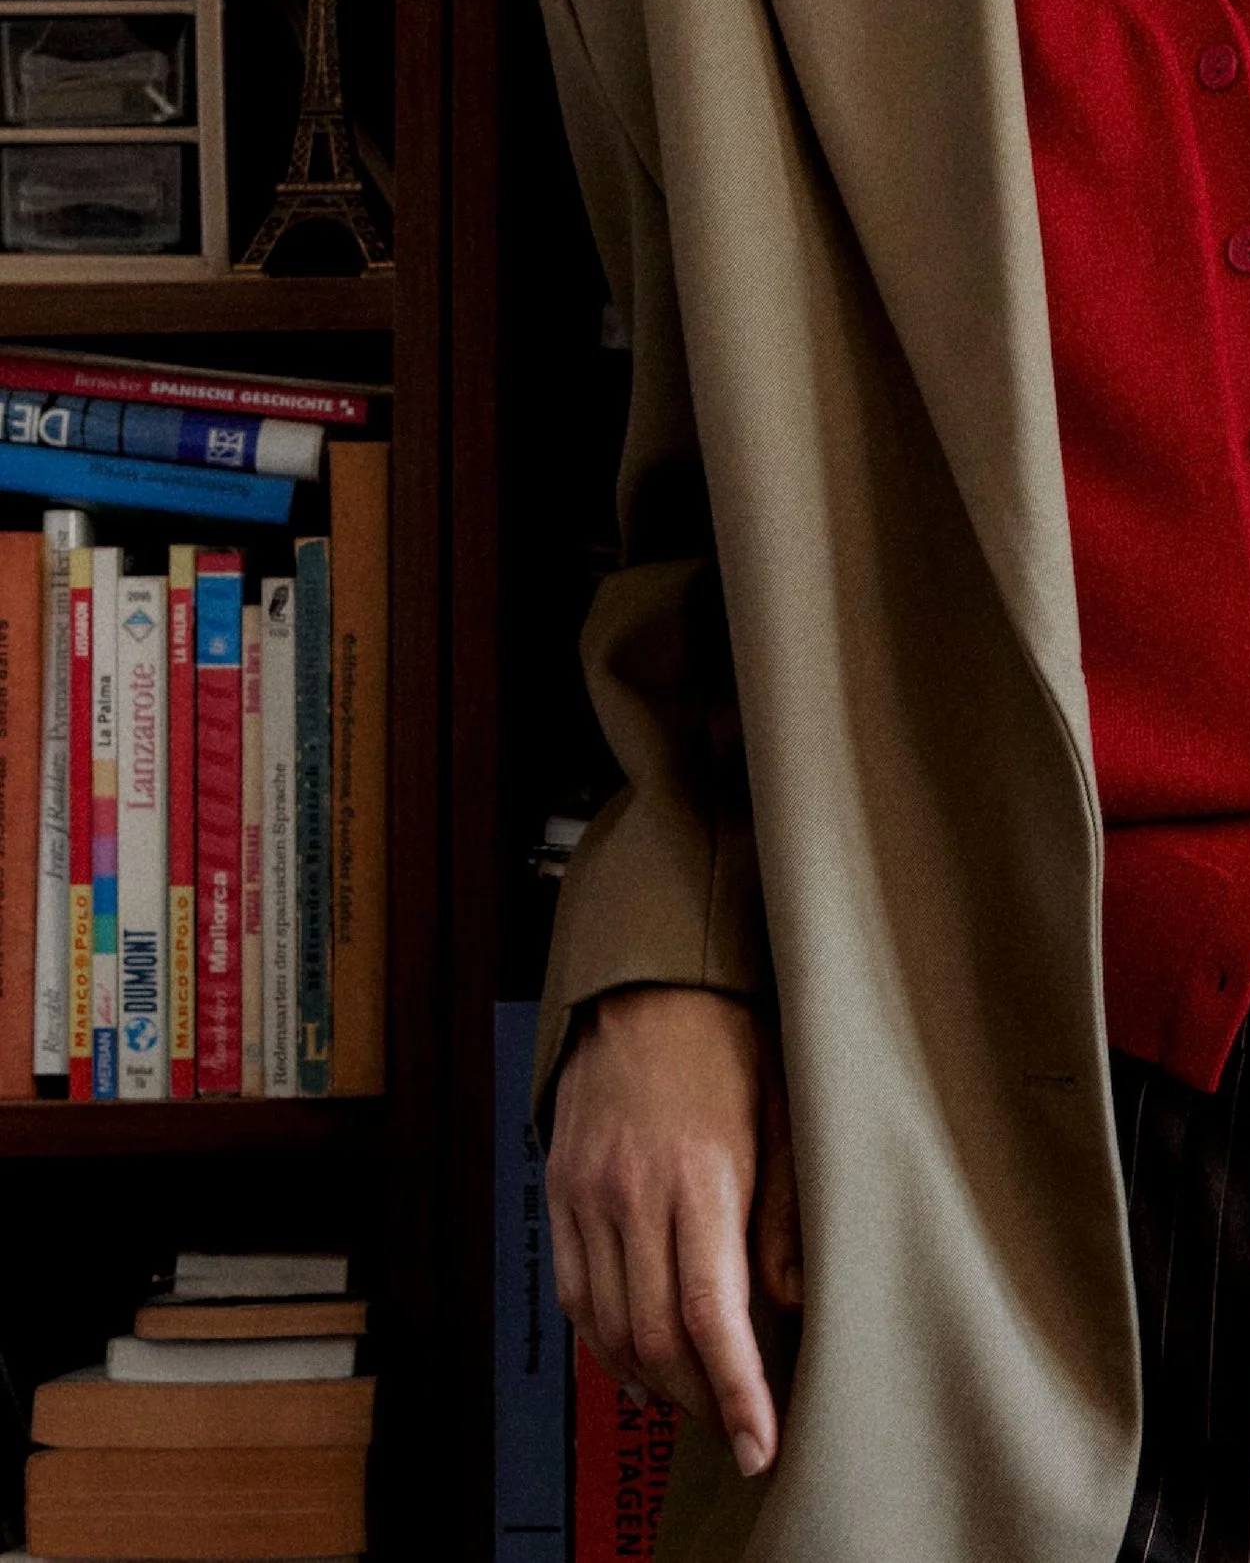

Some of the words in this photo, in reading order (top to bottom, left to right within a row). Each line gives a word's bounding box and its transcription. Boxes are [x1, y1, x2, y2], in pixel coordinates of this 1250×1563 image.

[149, 380, 236, 402] SPANISCHE
[239, 390, 335, 414] GESCHICHTE
[97, 674, 113, 725] Palma
[97, 727, 112, 748] La
[127, 662, 156, 812] Lanzarote
[273, 761, 292, 836] Sprache
[74, 894, 89, 951] POLO
[175, 894, 189, 951] POLO
[208, 869, 229, 974] Mallorca
[272, 839, 292, 939] spanischen
[123, 929, 158, 1014] DUMONT
[271, 942, 288, 972] der
[74, 973, 92, 1049] MARCO
[175, 973, 190, 1051] MARCO
[271, 974, 288, 1088] Redensarten
[616, 1445, 643, 1556] TAGEN
